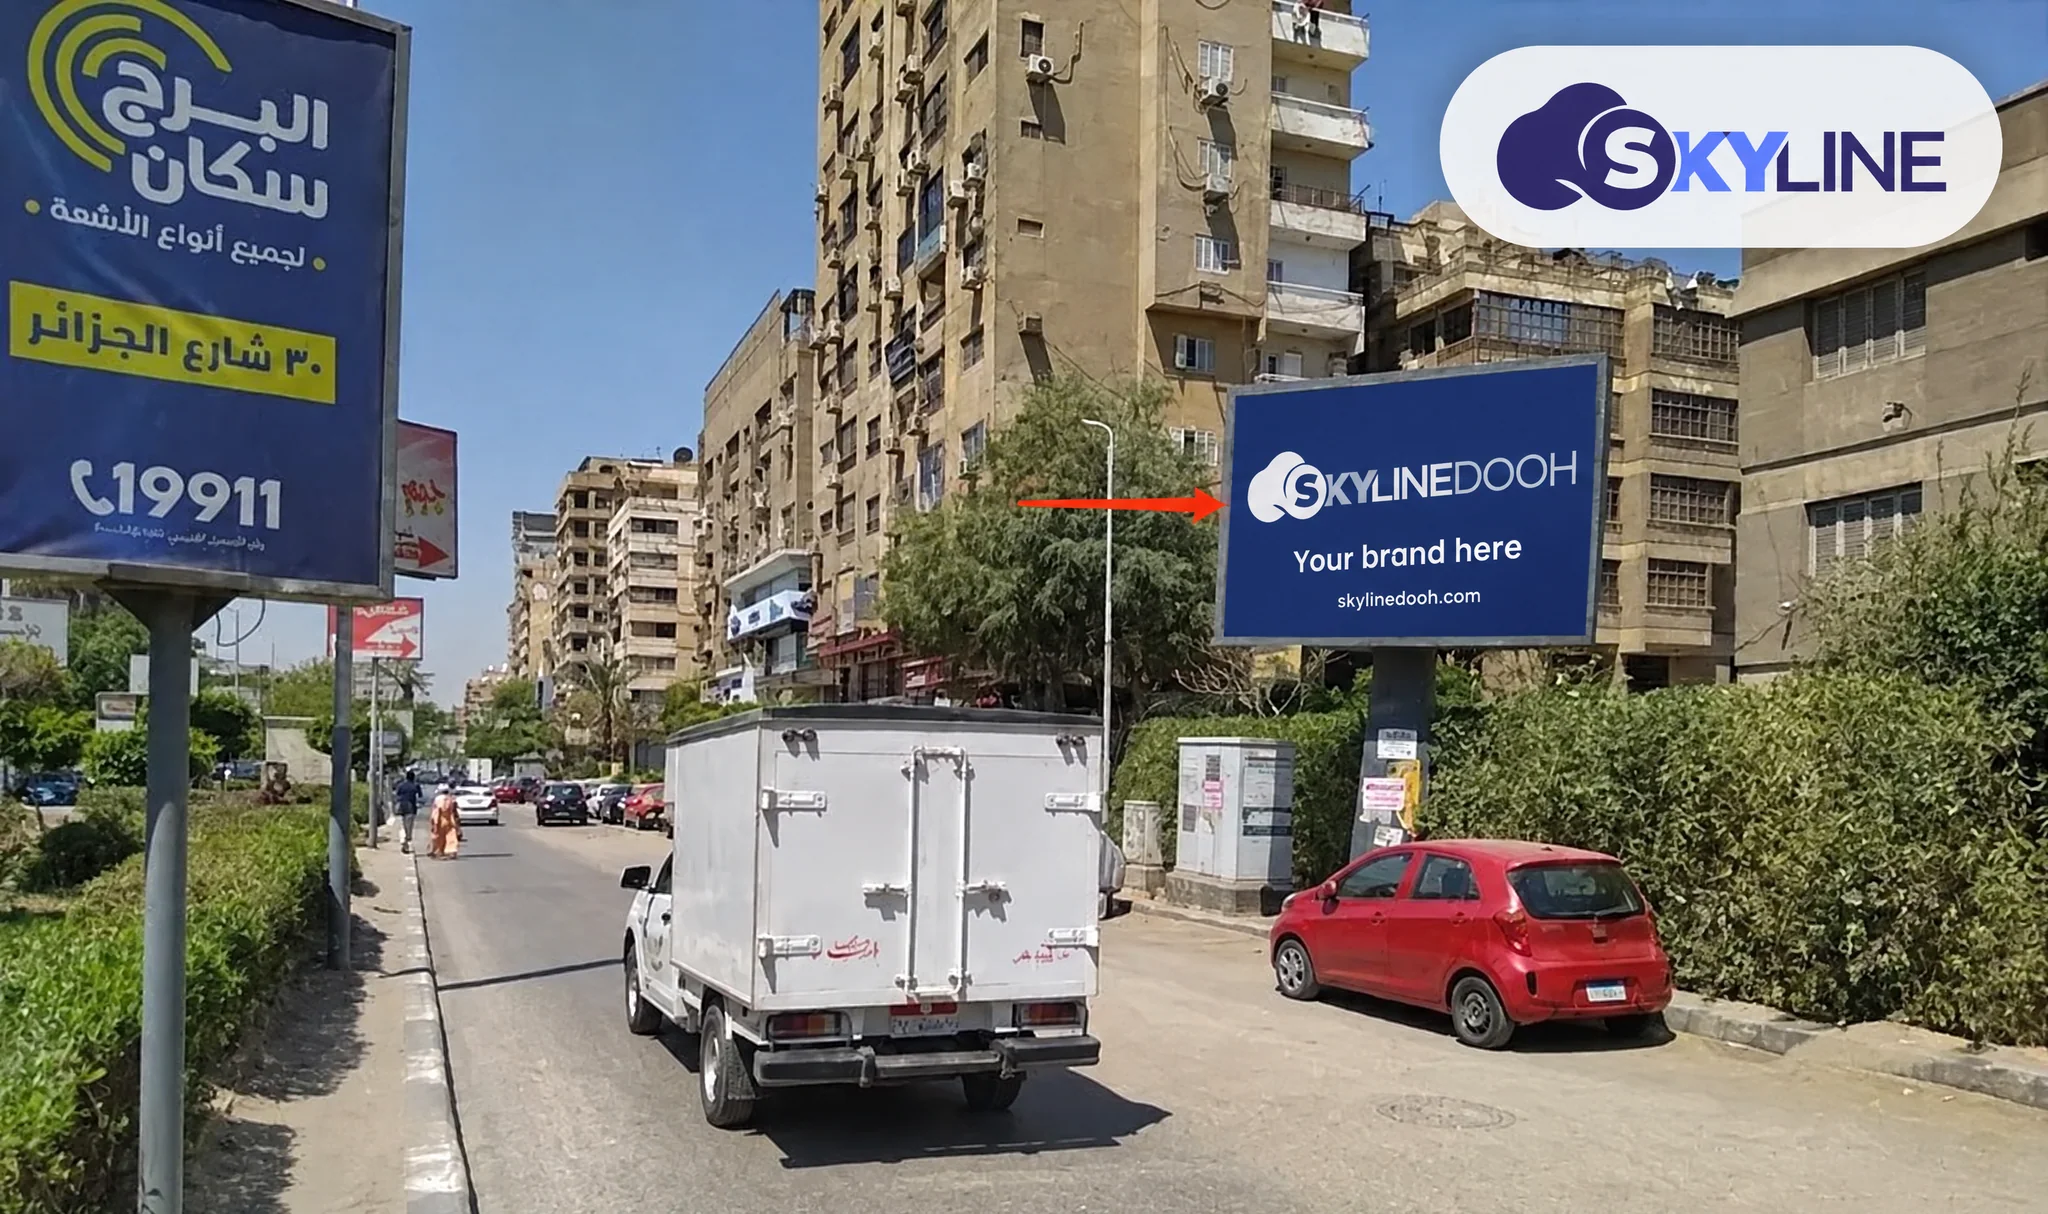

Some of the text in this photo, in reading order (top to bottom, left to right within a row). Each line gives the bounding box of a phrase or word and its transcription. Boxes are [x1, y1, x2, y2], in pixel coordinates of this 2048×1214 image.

[102, 60, 328, 153] البرج
[131, 136, 329, 219] سكان
[50, 197, 305, 271] لجميع أنواع الأشعة
[28, 301, 322, 376] ٣٠ شارع الجزائر
[112, 460, 282, 530] 19911
[1294, 450, 1578, 508] SKYLINEDOOH
[1293, 537, 1523, 574] Your brand here
[1337, 589, 1481, 612] skylinedooh.com
